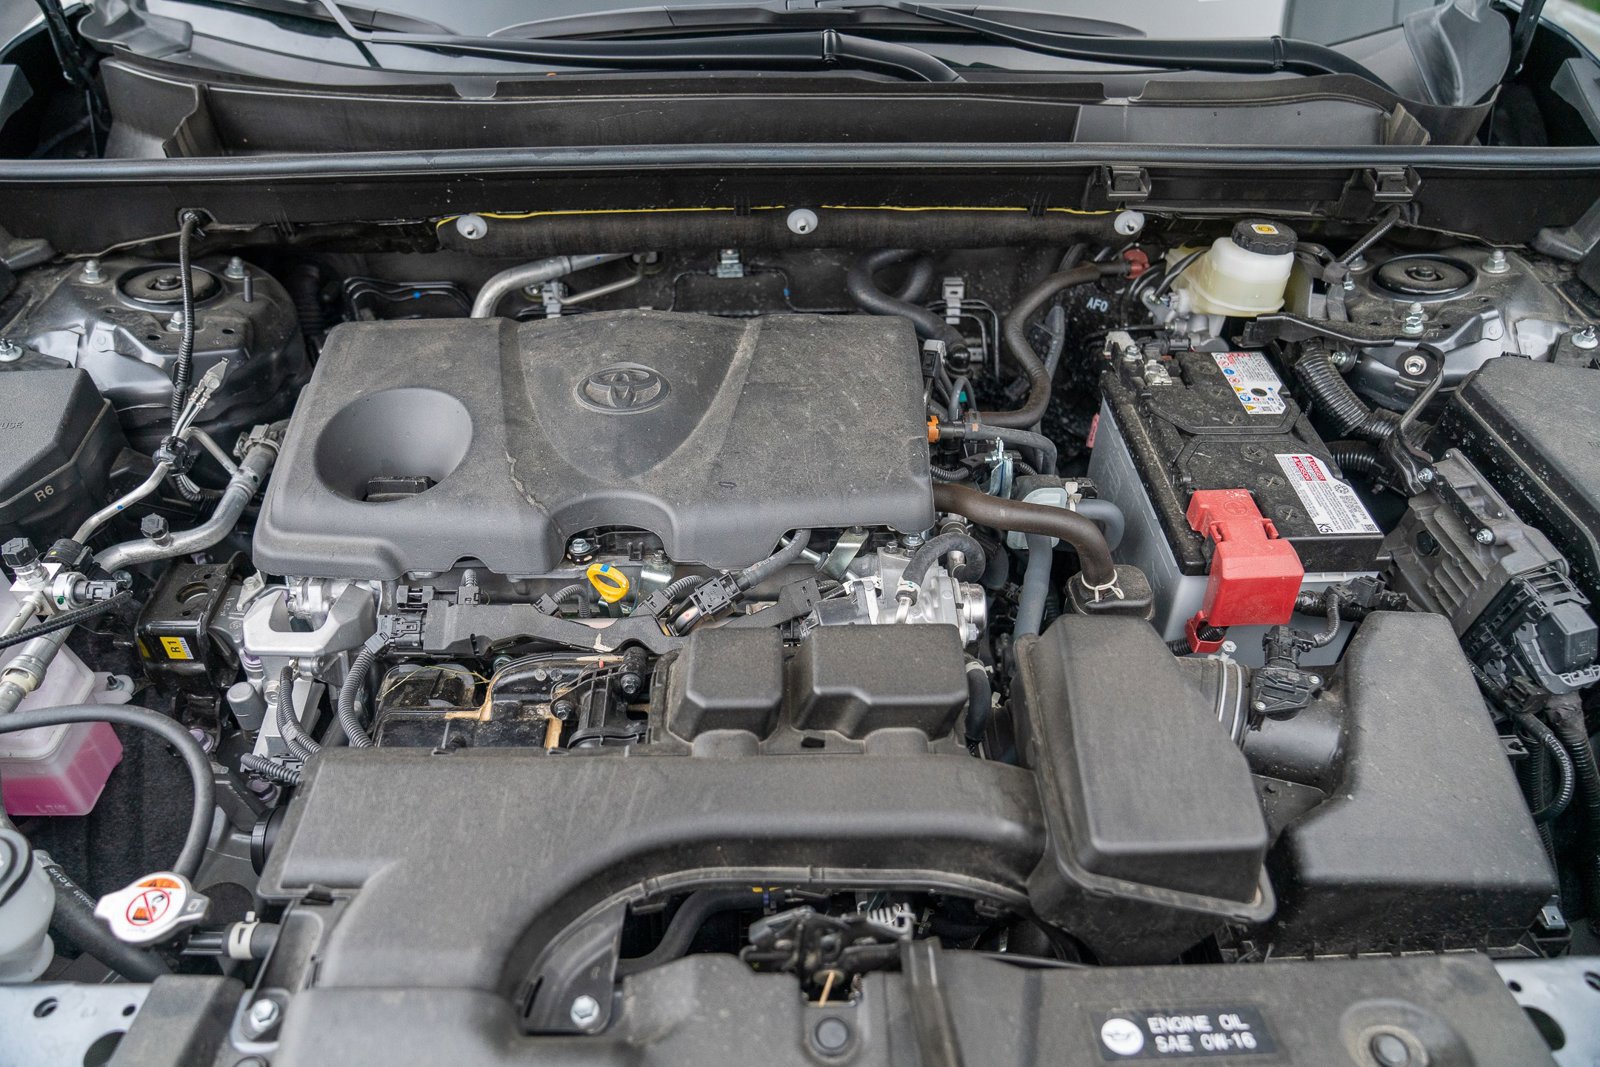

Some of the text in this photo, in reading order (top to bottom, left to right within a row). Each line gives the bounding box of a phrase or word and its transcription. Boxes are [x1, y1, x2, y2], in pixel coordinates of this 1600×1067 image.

[34, 485, 55, 502] R6
[1317, 523, 1333, 533] K5
[1147, 1014, 1250, 1034] ENGINE OIL
[1155, 1031, 1257, 1053] SAE 0W-16
